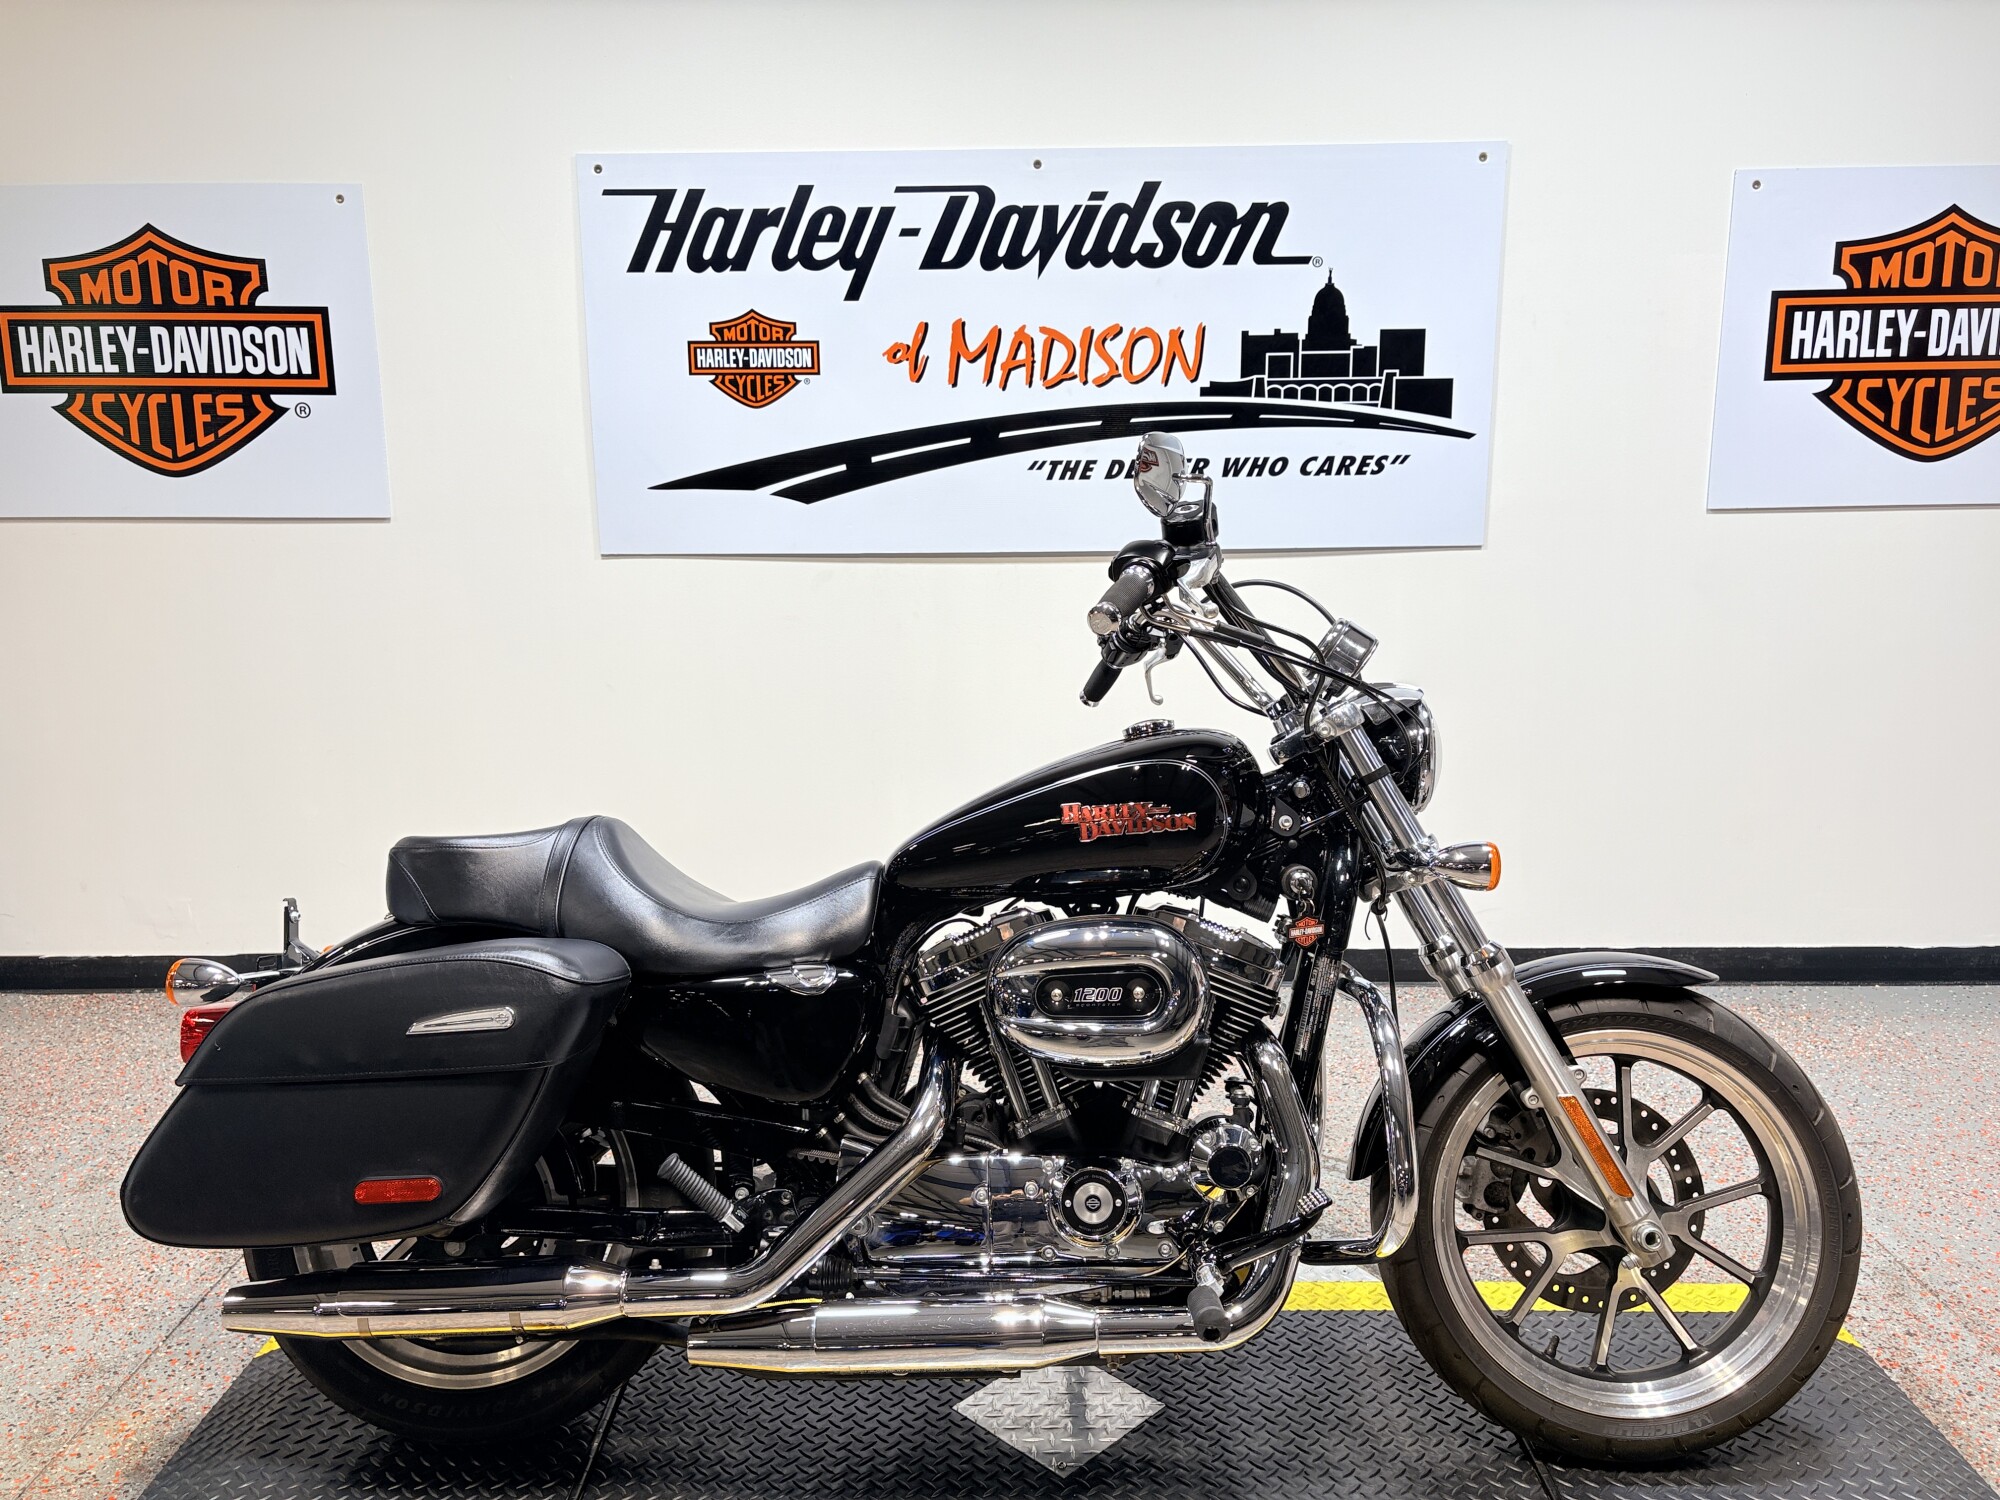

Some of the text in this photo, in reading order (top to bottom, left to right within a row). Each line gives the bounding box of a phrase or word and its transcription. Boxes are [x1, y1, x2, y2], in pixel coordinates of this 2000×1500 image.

[601, 180, 1313, 302] Harley-Davidson
[1869, 229, 2000, 289] MOTO
[80, 247, 234, 306] MOTOR
[723, 318, 784, 342] MOTOR
[1790, 308, 2000, 360] HARLEY-DAVI
[17, 326, 312, 374] HARLEY-DAVIDSON
[696, 348, 812, 368] HARLEY-DAVIDSON
[882, 318, 1206, 391] of MADISON
[724, 375, 785, 402] CYCLES
[93, 393, 245, 459] CYCLES
[1221, 456, 1289, 478] WHO
[1079, 812, 1196, 842] DAVIDSON
[1073, 987, 1123, 1002] 1200
[1559, 1013, 1692, 1036] EY-DAVIDSON
